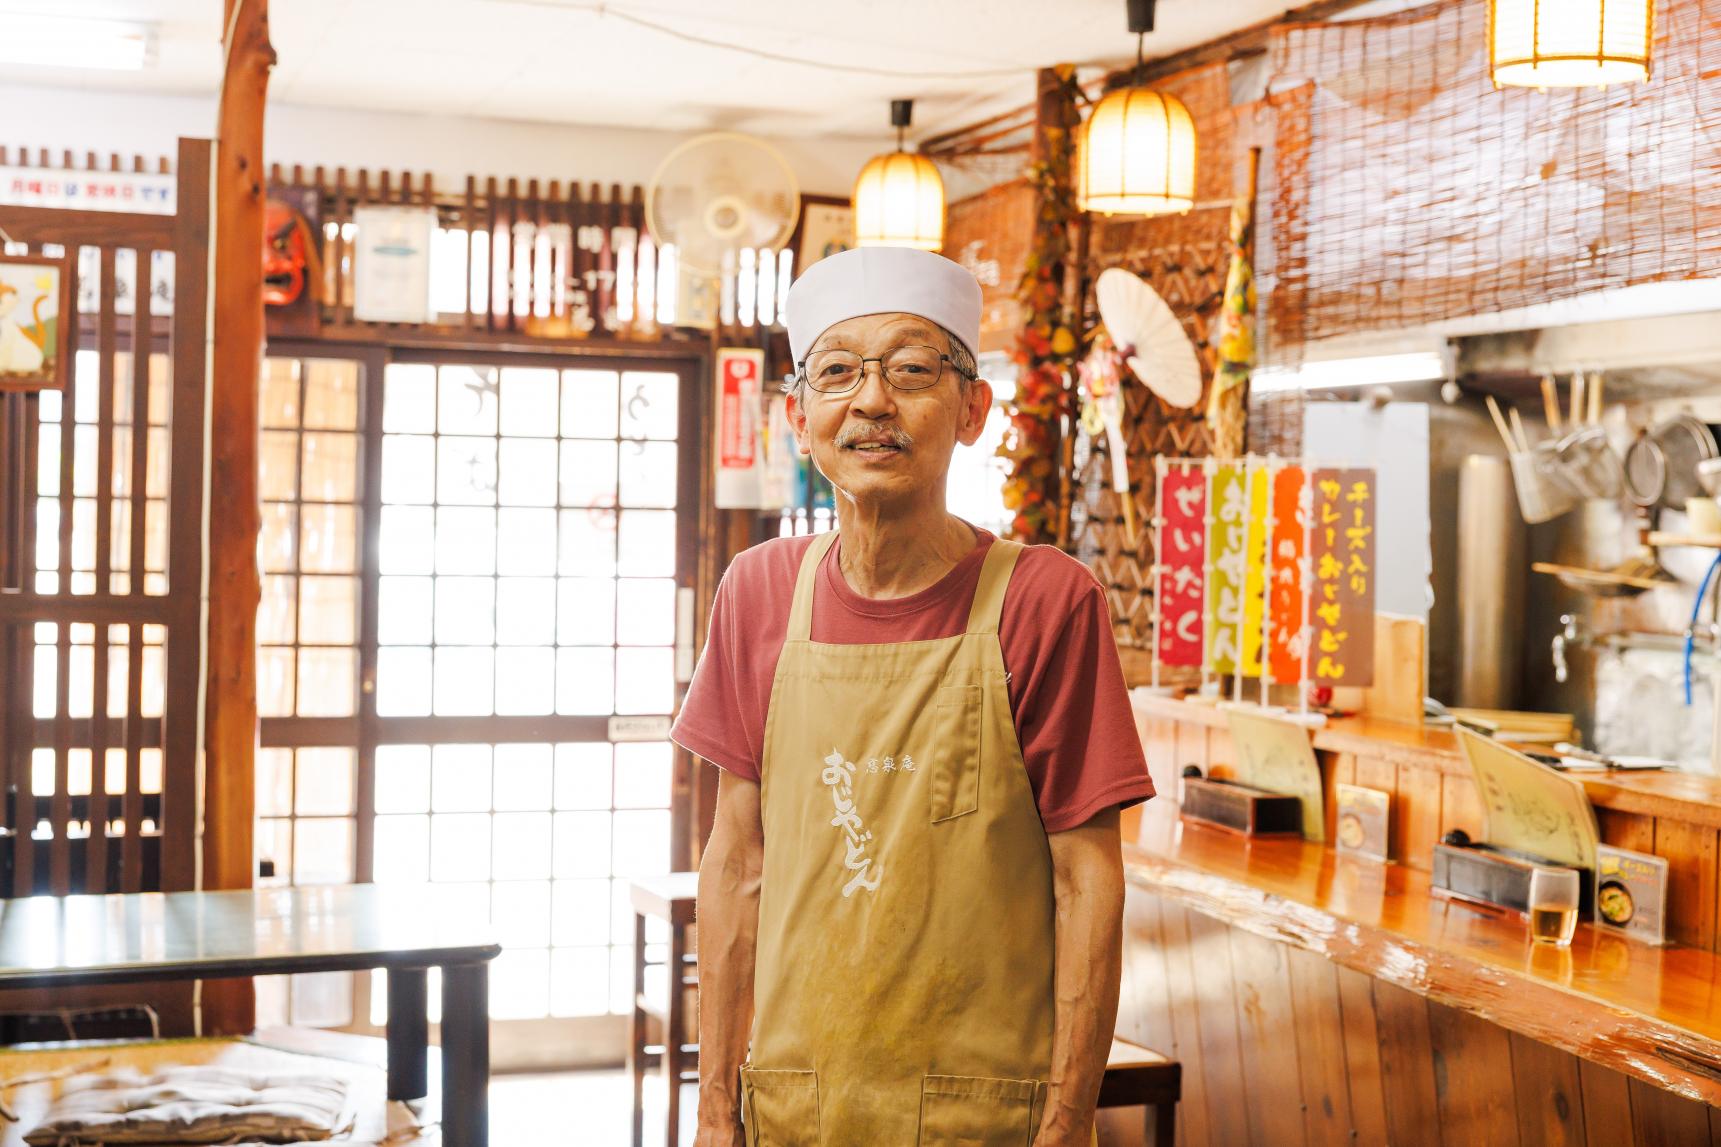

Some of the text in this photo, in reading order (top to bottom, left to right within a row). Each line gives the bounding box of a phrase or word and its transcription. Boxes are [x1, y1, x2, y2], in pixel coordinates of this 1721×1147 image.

[1174, 486, 1204, 641] ぜいたく
[1346, 481, 1372, 595] チーズ入り
[822, 747, 884, 897] おじやどん
